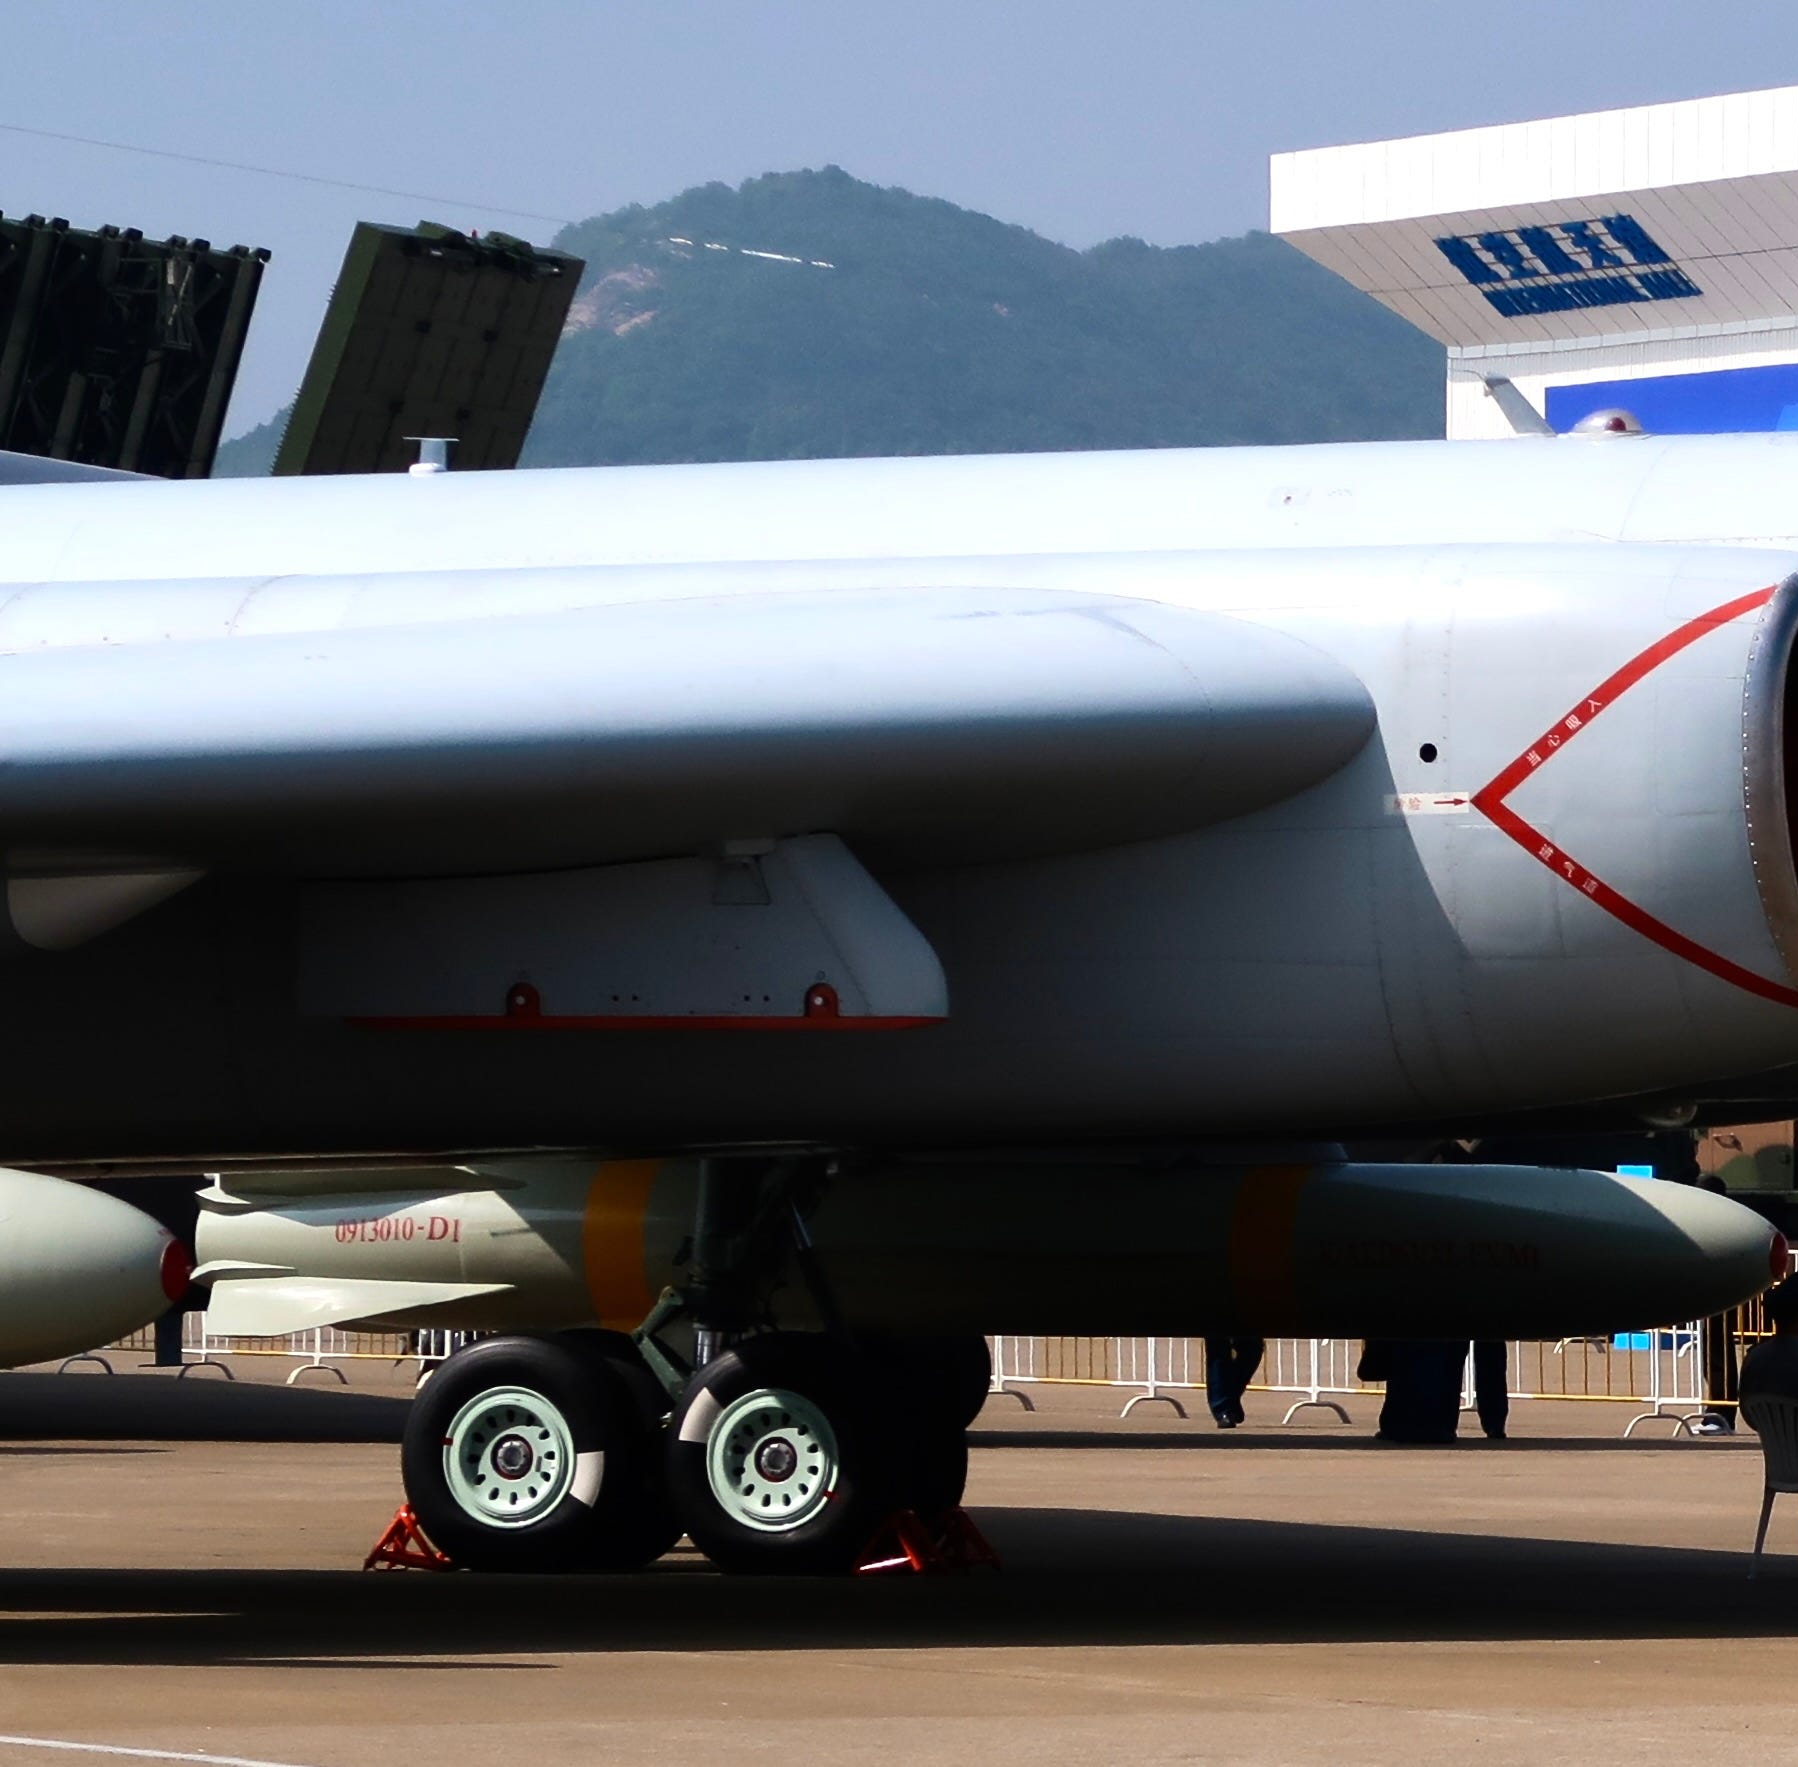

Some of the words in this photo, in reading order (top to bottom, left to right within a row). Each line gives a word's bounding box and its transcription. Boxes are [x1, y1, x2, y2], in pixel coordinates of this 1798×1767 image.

[1526, 698, 1602, 768] 当心吸入
[335, 1216, 460, 1243] 0913010-D1
